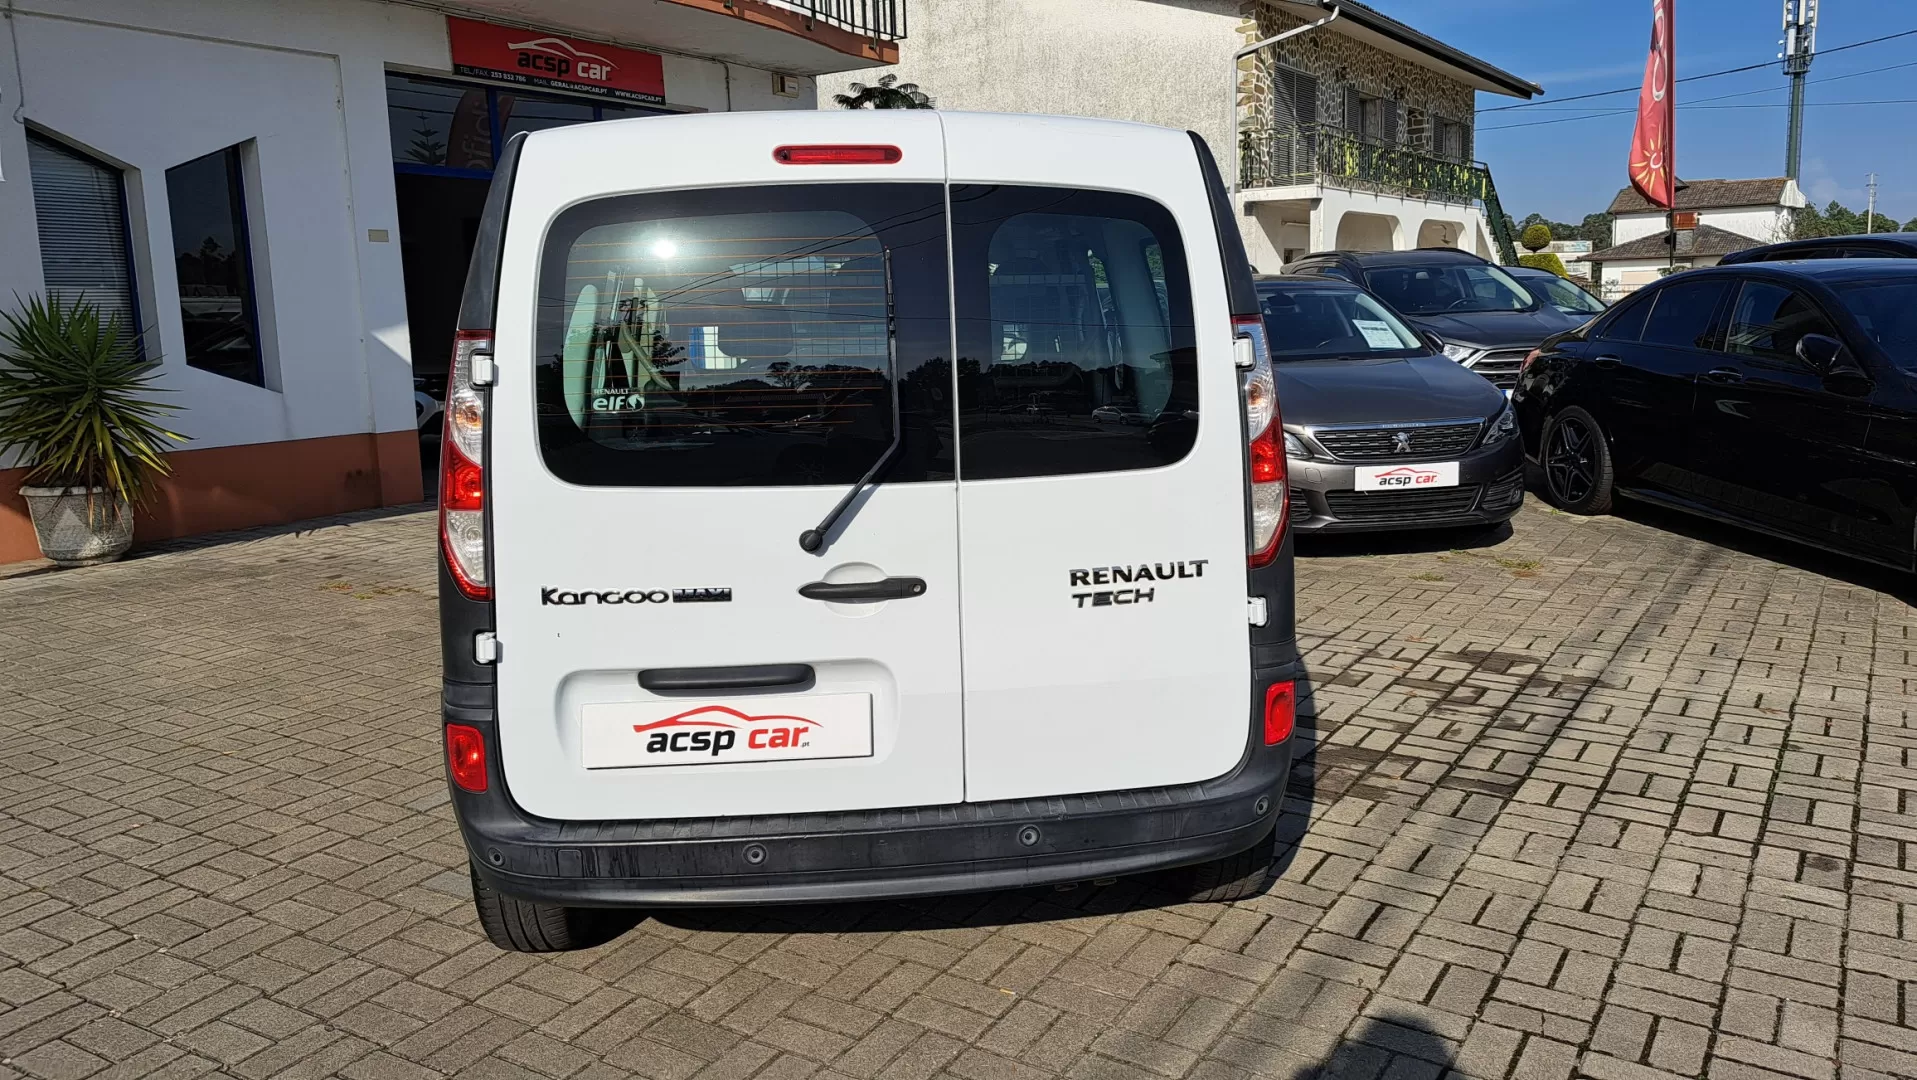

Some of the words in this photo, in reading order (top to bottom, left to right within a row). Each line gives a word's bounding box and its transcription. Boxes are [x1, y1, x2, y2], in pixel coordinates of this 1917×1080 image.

[517, 51, 570, 78] acsp
[577, 61, 611, 81] car
[592, 395, 626, 411] elf
[1379, 476, 1412, 487] acsp
[1415, 474, 1438, 484] car
[1069, 559, 1209, 587] RENAULT
[541, 586, 670, 606] Kangoo
[1071, 587, 1155, 609] TECH
[646, 729, 736, 756] acsp
[747, 726, 809, 750] car
